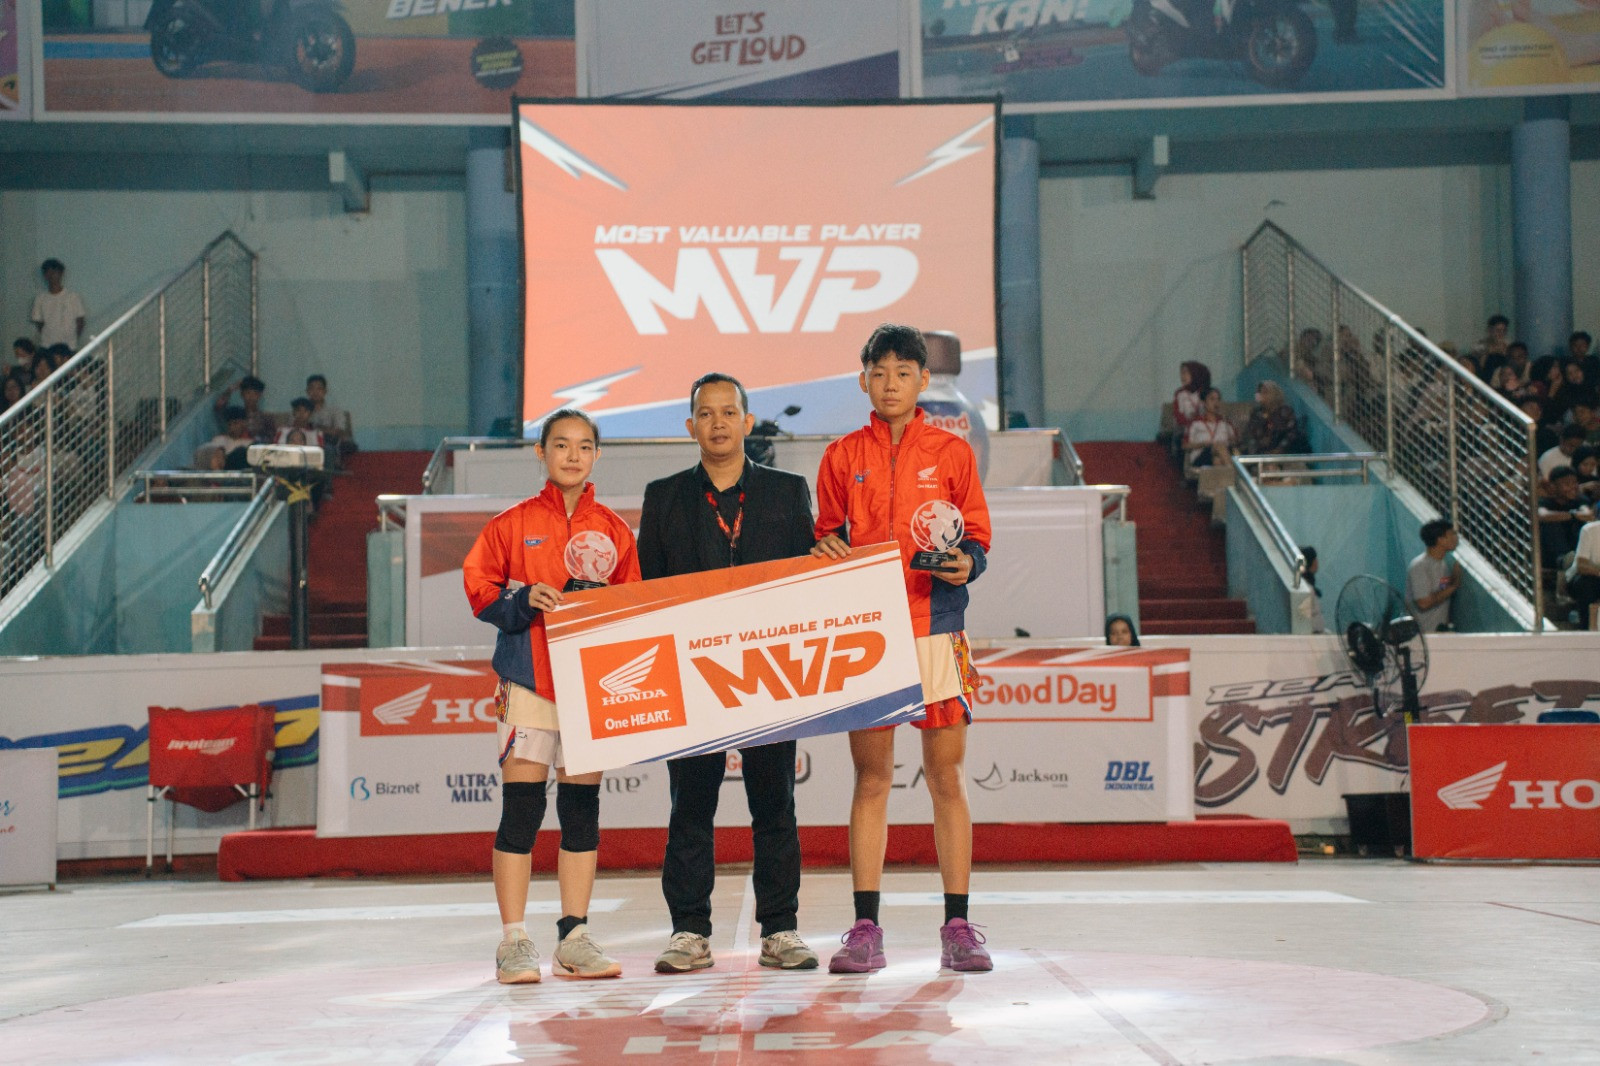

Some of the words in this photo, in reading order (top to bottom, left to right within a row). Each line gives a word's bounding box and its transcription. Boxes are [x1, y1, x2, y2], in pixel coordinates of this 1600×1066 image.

[715, 11, 765, 35] LET'S
[691, 40, 739, 65] GET
[738, 34, 806, 66] LOUD
[594, 225, 670, 244] MOST
[679, 225, 811, 243] VALUABLE
[820, 223, 922, 241] PLAYER
[594, 246, 919, 335] MVP
[923, 411, 969, 432] ood
[688, 633, 732, 651] MOST
[738, 620, 818, 643] VALUABLE
[824, 610, 883, 629] PLAYER
[690, 630, 887, 710] MVP
[601, 687, 668, 706] HONDA
[973, 674, 1052, 706] Good
[1057, 674, 1117, 712] Day
[604, 716, 630, 731] One
[630, 709, 672, 728] HEART.
[446, 773, 498, 789] ULTRA
[1009, 769, 1068, 783] Jackson
[1104, 761, 1154, 782] DBL
[376, 782, 420, 796] Biznet
[451, 788, 493, 803] MILK
